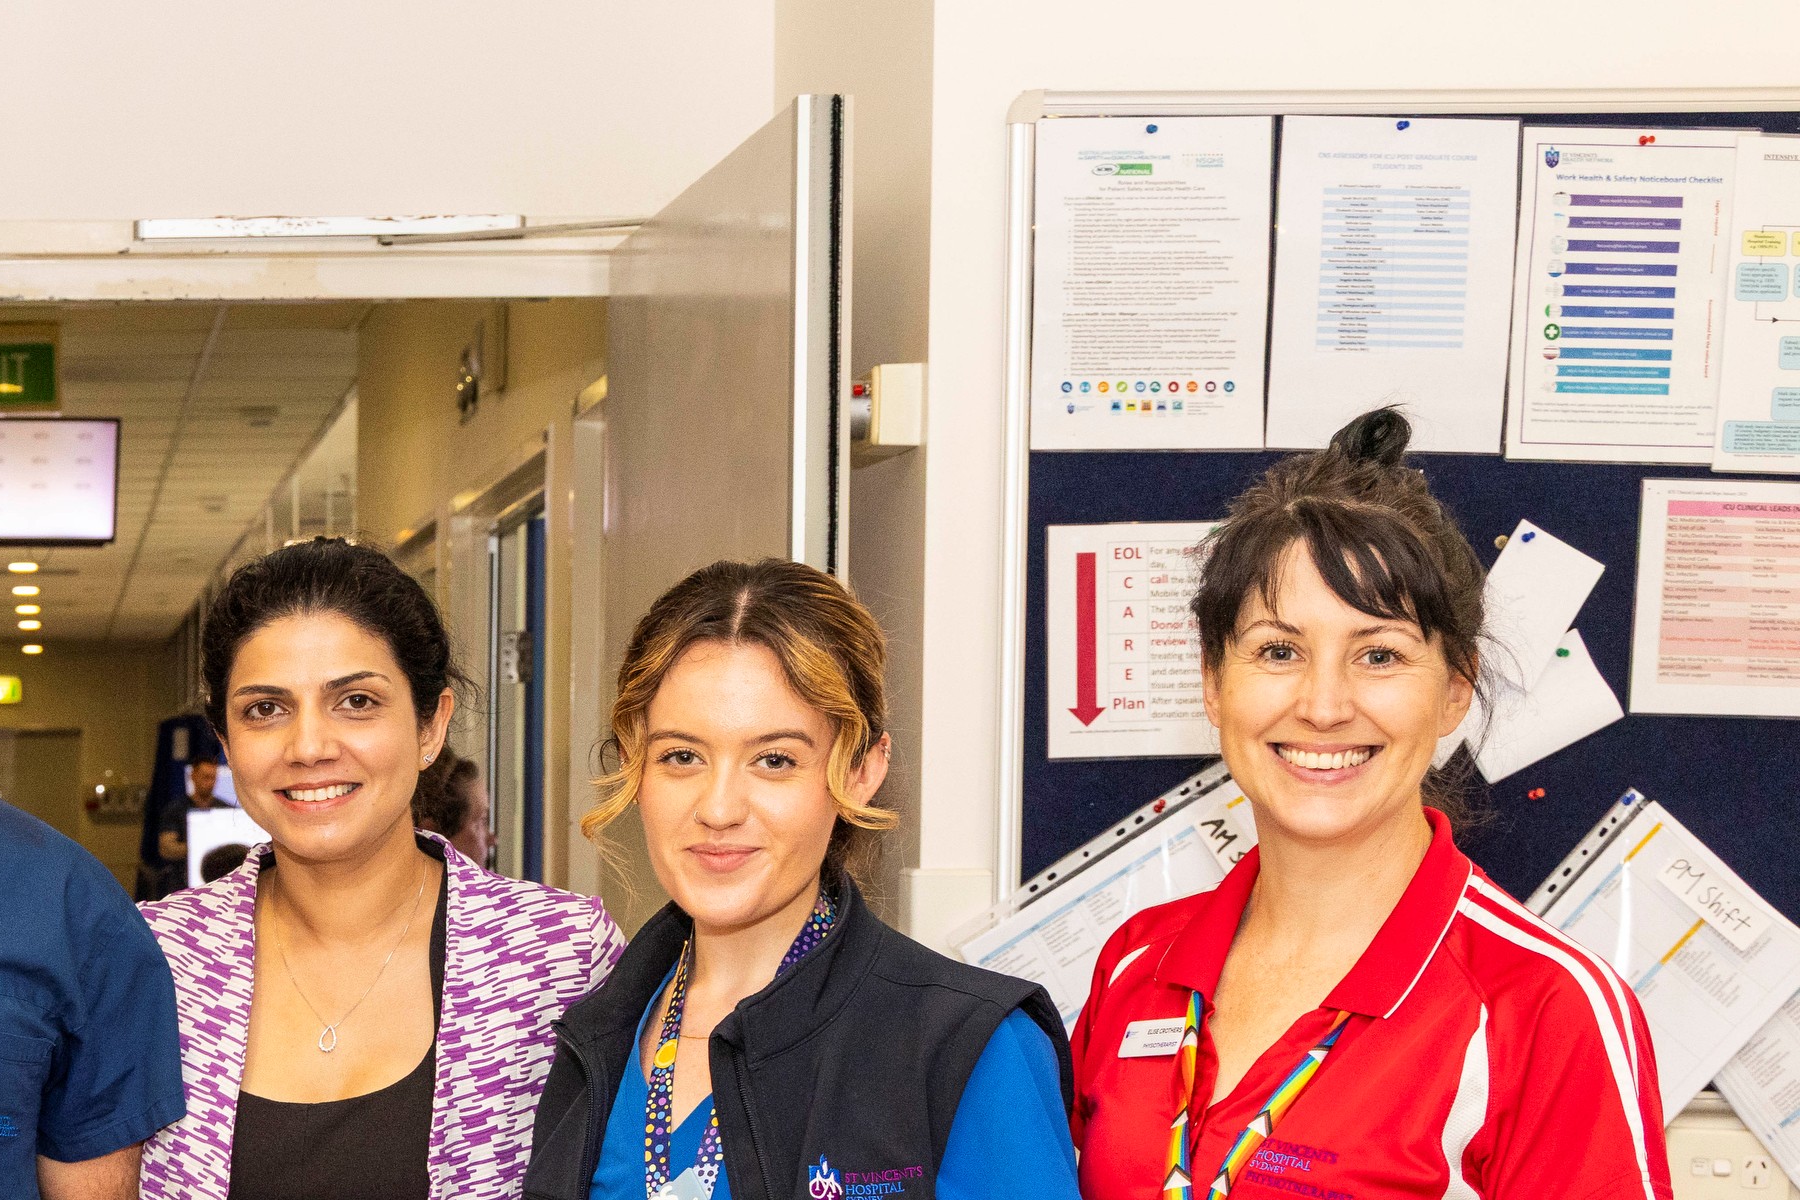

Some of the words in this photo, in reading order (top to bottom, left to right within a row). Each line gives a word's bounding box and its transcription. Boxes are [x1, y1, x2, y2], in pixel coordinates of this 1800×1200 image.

[1579, 174, 1604, 182] Health
[1613, 175, 1638, 184] Safety
[1639, 176, 1687, 184] Noticeboard
[1689, 176, 1723, 184] Checklist
[1722, 503, 1735, 511] ICU
[1737, 504, 1767, 512] CLINICAL
[1114, 547, 1142, 560] EOL
[1124, 576, 1133, 589] C
[1150, 574, 1169, 584] call
[1123, 606, 1134, 618] A
[1151, 620, 1183, 630] Donor
[1124, 639, 1134, 651] R
[1151, 638, 1187, 646] review
[1125, 669, 1133, 681] E
[1113, 697, 1145, 710] Plan
[1200, 819, 1238, 854] AM
[1665, 859, 1705, 894] PM
[1698, 887, 1752, 931] Shift
[1159, 1026, 1183, 1035] CROTHERS
[1255, 1149, 1312, 1172] HOSPITAL
[1249, 1161, 1286, 1174] SYDNEY
[844, 1172, 858, 1183] ST
[861, 1165, 924, 1183] VINCENT'S
[845, 1181, 905, 1195] HOSPITAL
